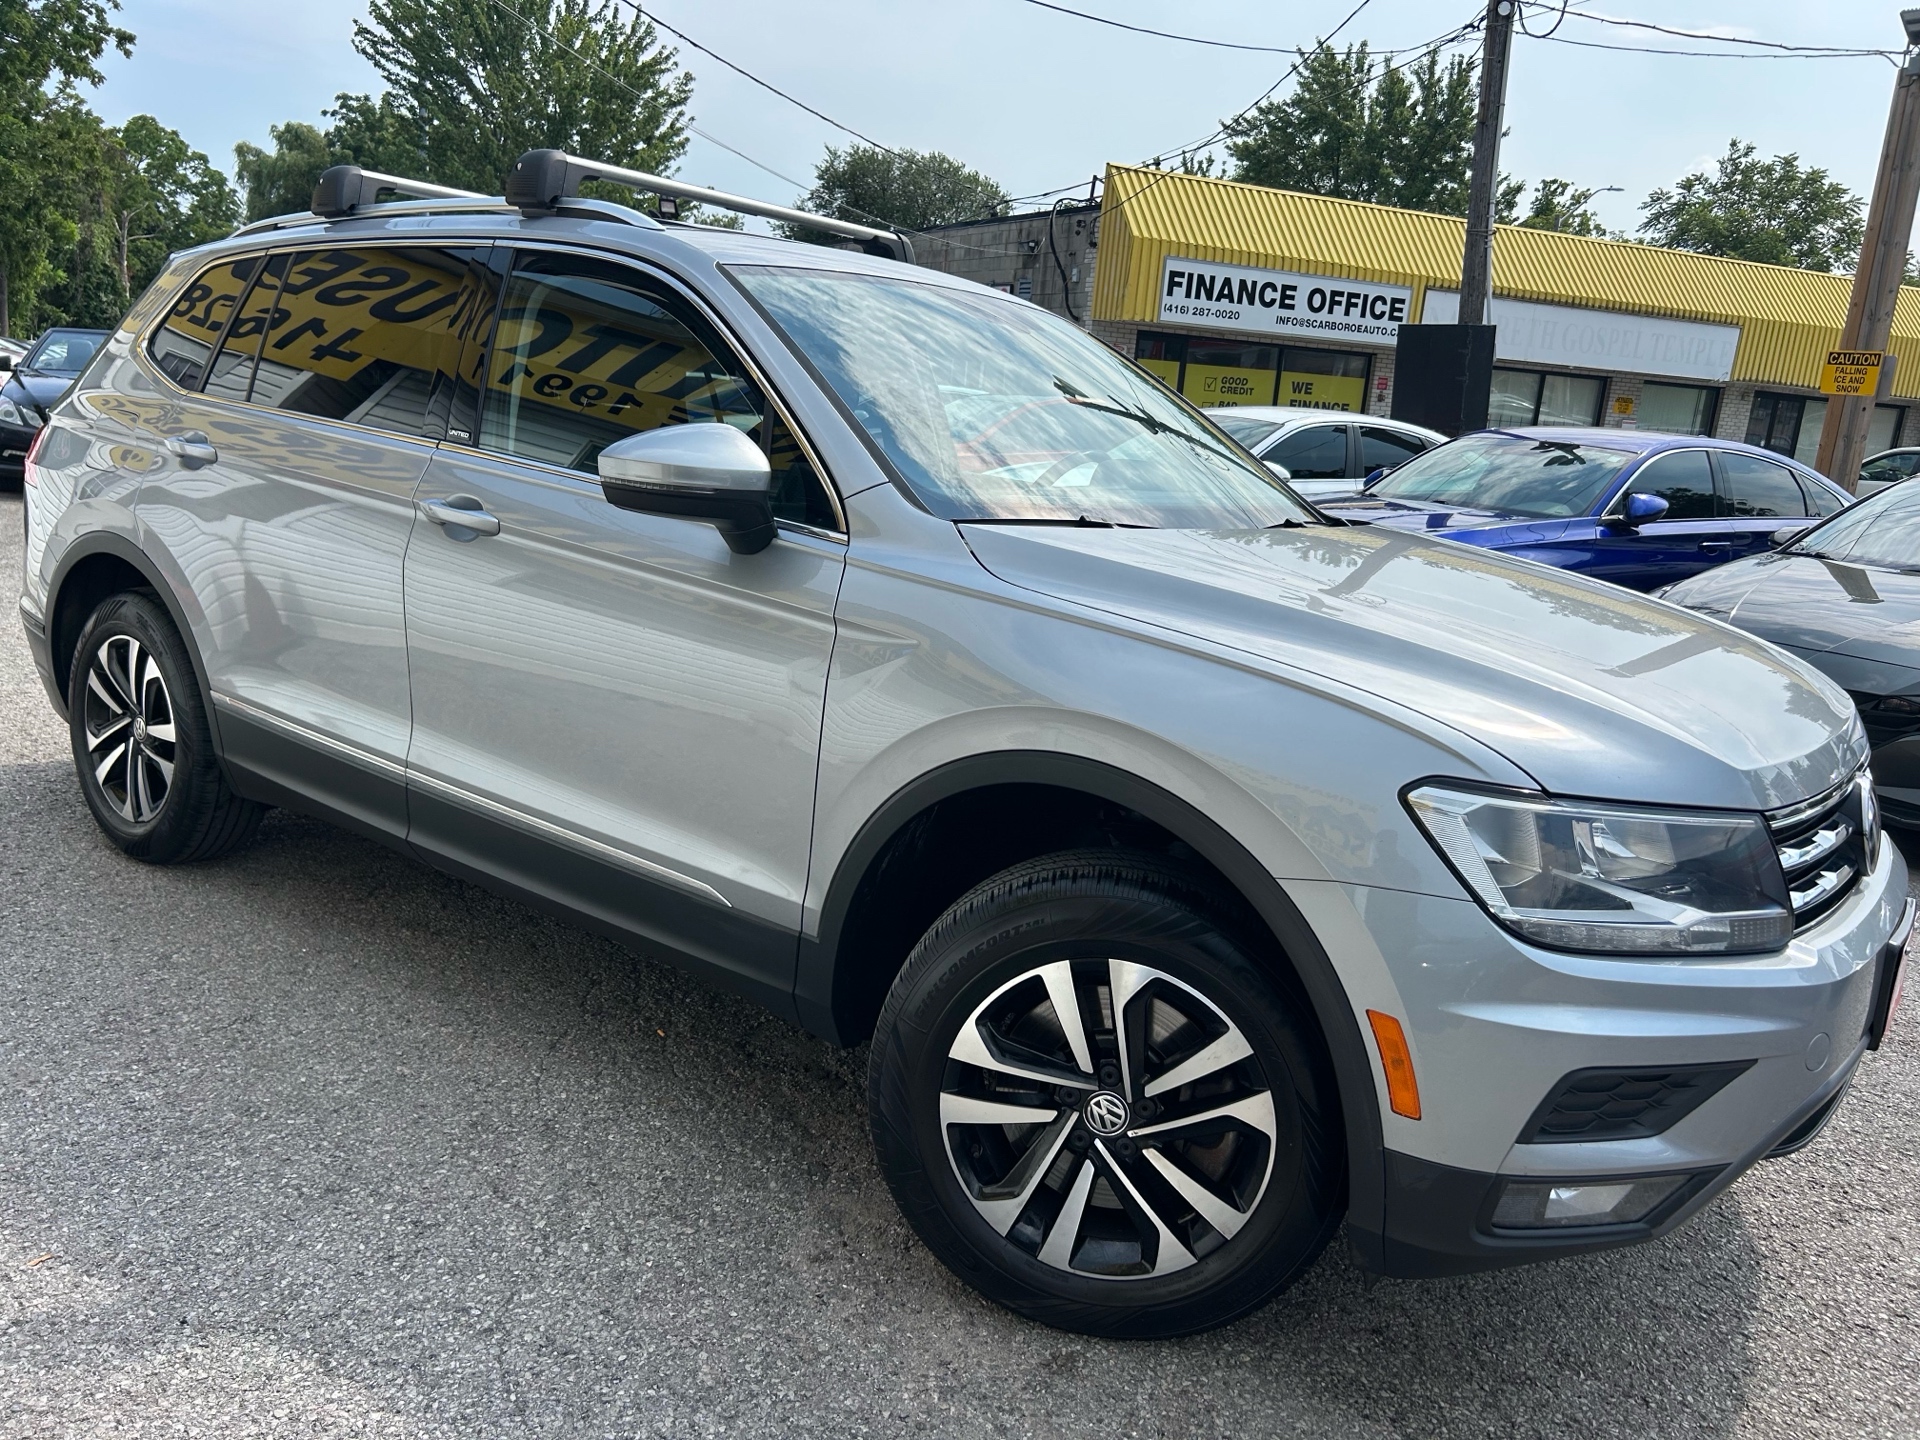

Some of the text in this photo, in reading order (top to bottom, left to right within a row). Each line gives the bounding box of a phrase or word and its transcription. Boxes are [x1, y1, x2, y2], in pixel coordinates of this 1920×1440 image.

[1166, 270, 1406, 322] FINANCE OFFICE
[1163, 303, 1241, 321] (416) 287-0020
[1275, 315, 1398, 337] INFO@SCARBOROEAUTO.C
[1561, 322, 1645, 360] GOSPEL
[1650, 332, 1734, 369] TEMPLE
[1829, 353, 1879, 366] CAUTION
[1834, 366, 1868, 376] FALLING
[1221, 376, 1249, 386] GOOD
[1833, 375, 1866, 385] ICE AND
[1220, 385, 1255, 396] CREDIT
[1291, 381, 1314, 395] WE
[1835, 384, 1861, 394] SNOW
[1289, 399, 1350, 412] FINANCE
